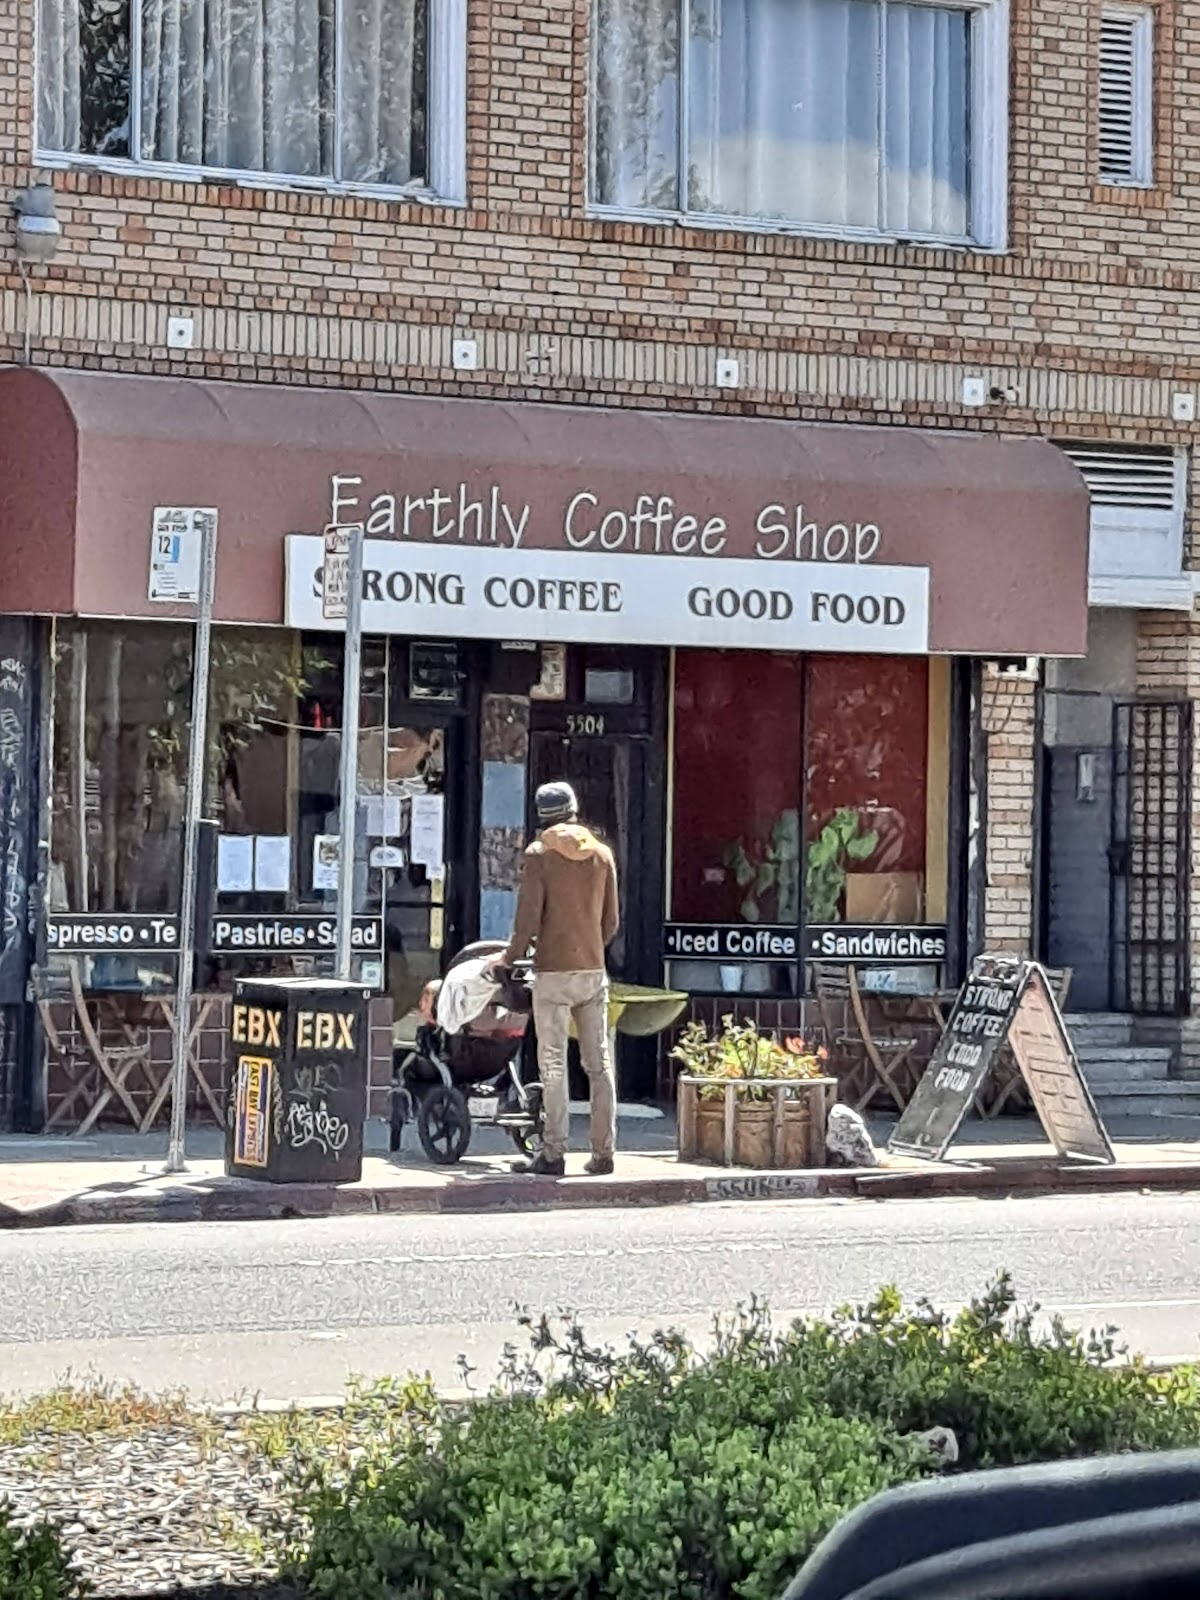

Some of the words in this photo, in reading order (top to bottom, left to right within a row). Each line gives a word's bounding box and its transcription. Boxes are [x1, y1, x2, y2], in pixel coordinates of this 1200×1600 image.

[331, 475, 530, 549] Earthly
[565, 492, 727, 554] Coffee
[756, 504, 881, 564] Shop
[159, 535, 171, 554] 12
[312, 564, 466, 606] SRONG
[483, 576, 623, 613] COFFEE
[688, 586, 793, 621] GOOD
[811, 591, 906, 626] FOOD
[46, 922, 134, 948] spresso
[151, 920, 177, 943] Te
[215, 921, 306, 946] Pastries
[675, 928, 719, 953] Iced
[726, 930, 796, 955] Coffee
[821, 931, 946, 956] Sandwiches
[963, 984, 1014, 1012] STRONG
[232, 1004, 282, 1048] EBX
[297, 1011, 355, 1051] EBX
[952, 1011, 1005, 1037] COFFEE
[934, 1067, 971, 1092] FOOD
